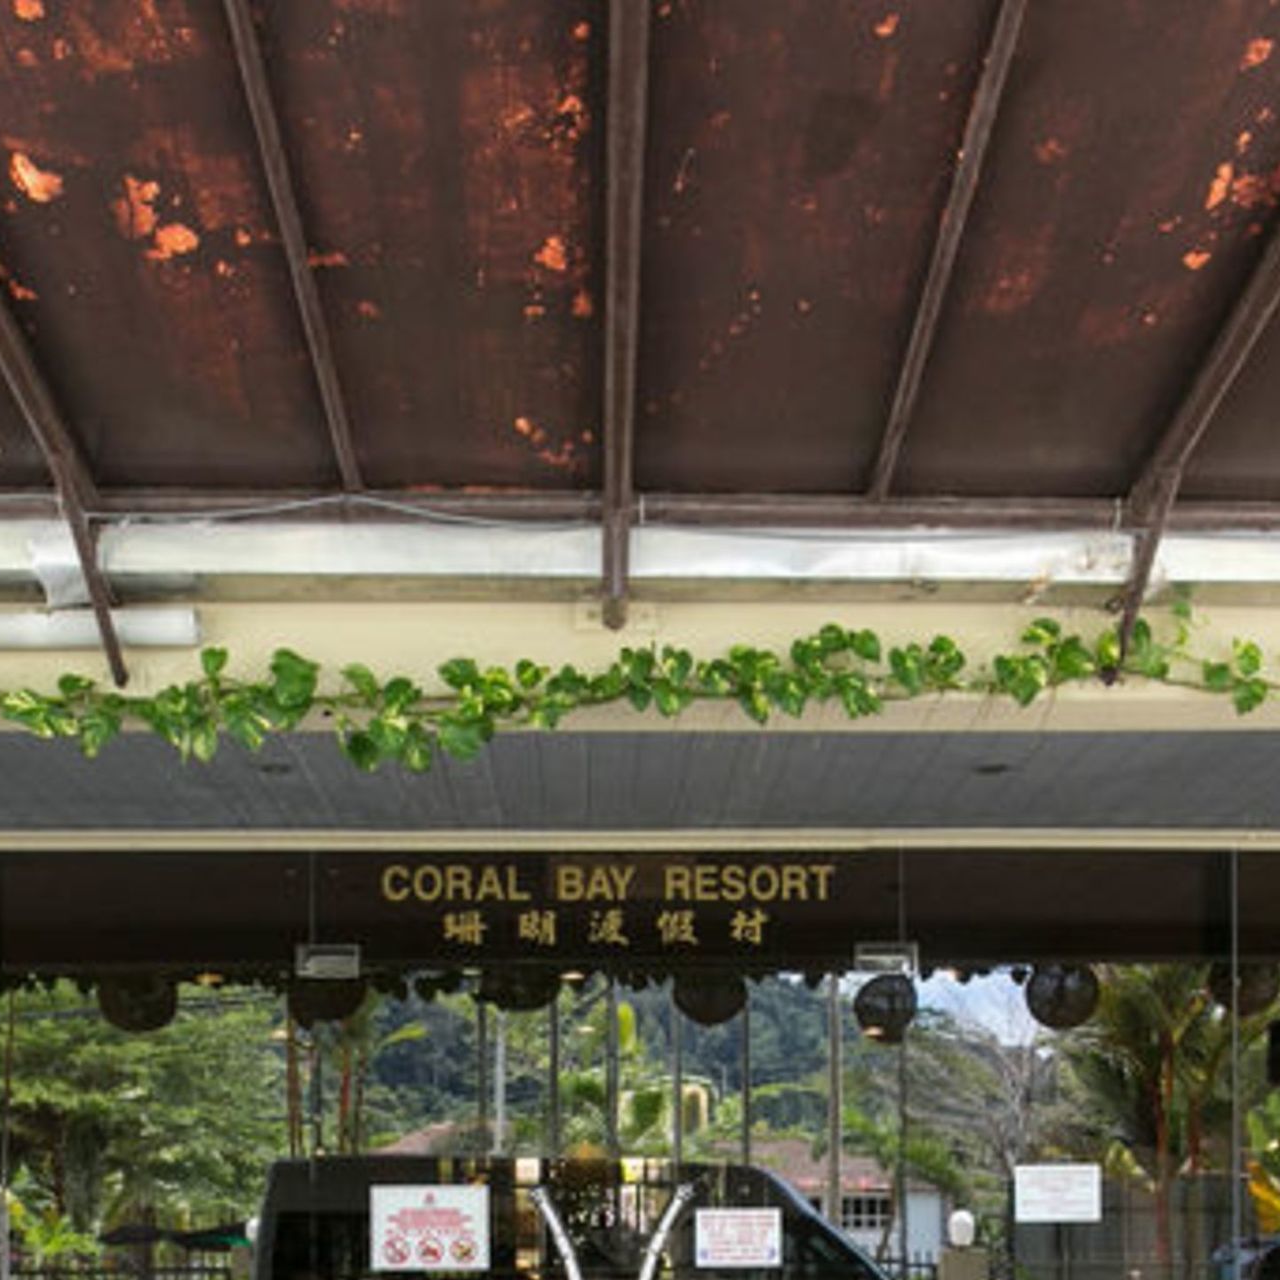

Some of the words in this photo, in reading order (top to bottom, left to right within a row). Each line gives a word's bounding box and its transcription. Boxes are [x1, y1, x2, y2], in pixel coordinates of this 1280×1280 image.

[381, 864, 531, 902] CORAL
[556, 864, 635, 901] BAY
[664, 863, 836, 901] RESORT
